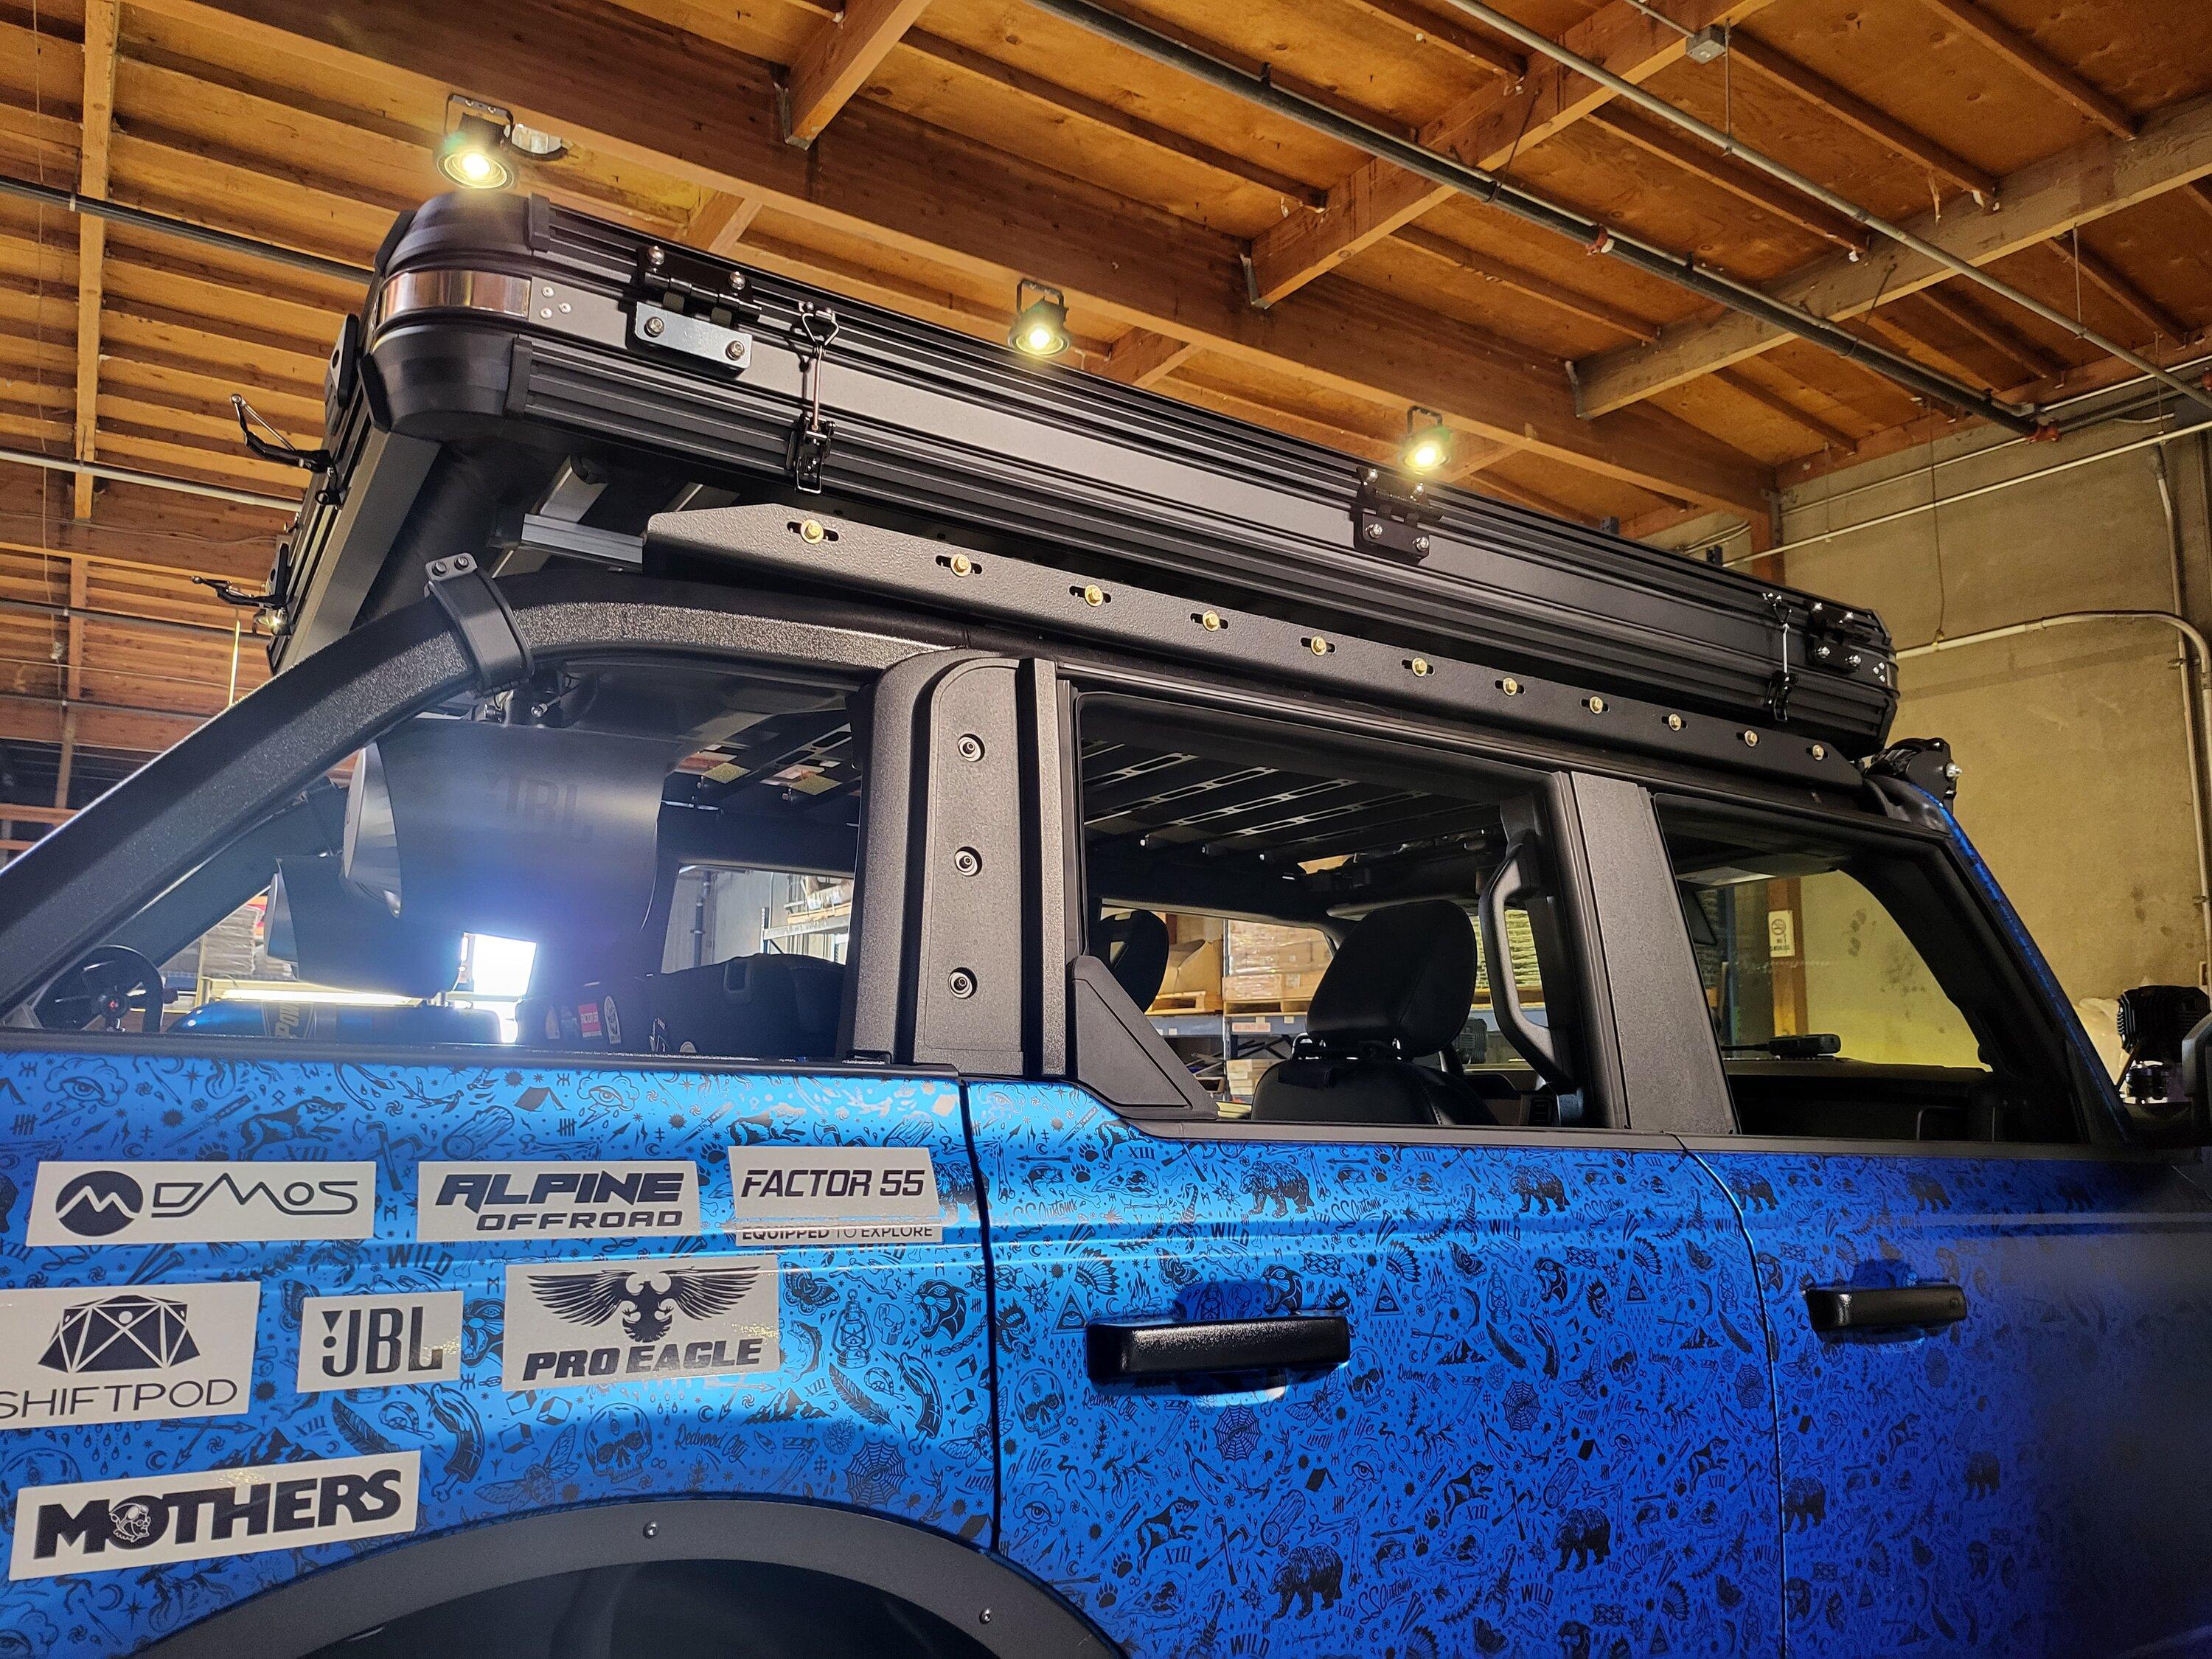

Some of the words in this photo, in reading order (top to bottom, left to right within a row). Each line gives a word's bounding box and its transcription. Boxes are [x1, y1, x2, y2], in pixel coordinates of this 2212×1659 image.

[151, 1172, 358, 1218] DMOS
[436, 1169, 684, 1214] ALPINE
[741, 1169, 872, 1197] FACTOR
[880, 1169, 925, 1196] 55
[476, 1210, 683, 1231] OFFROAD
[742, 1226, 830, 1240] EQUIPPED
[837, 1226, 856, 1239] TO
[861, 1225, 932, 1238] EXPLORE
[1210, 1222, 1249, 1248] WILD
[1489, 1220, 1520, 1242] WILD
[386, 1243, 454, 1277] WILD
[322, 1307, 442, 1377] JBL
[523, 1349, 622, 1381] PRO
[625, 1338, 763, 1374] EAGLE
[0, 1379, 237, 1419] SHIFTPOD
[34, 1470, 402, 1559] MOTHERS
[1230, 1634, 1270, 1658] WILD
